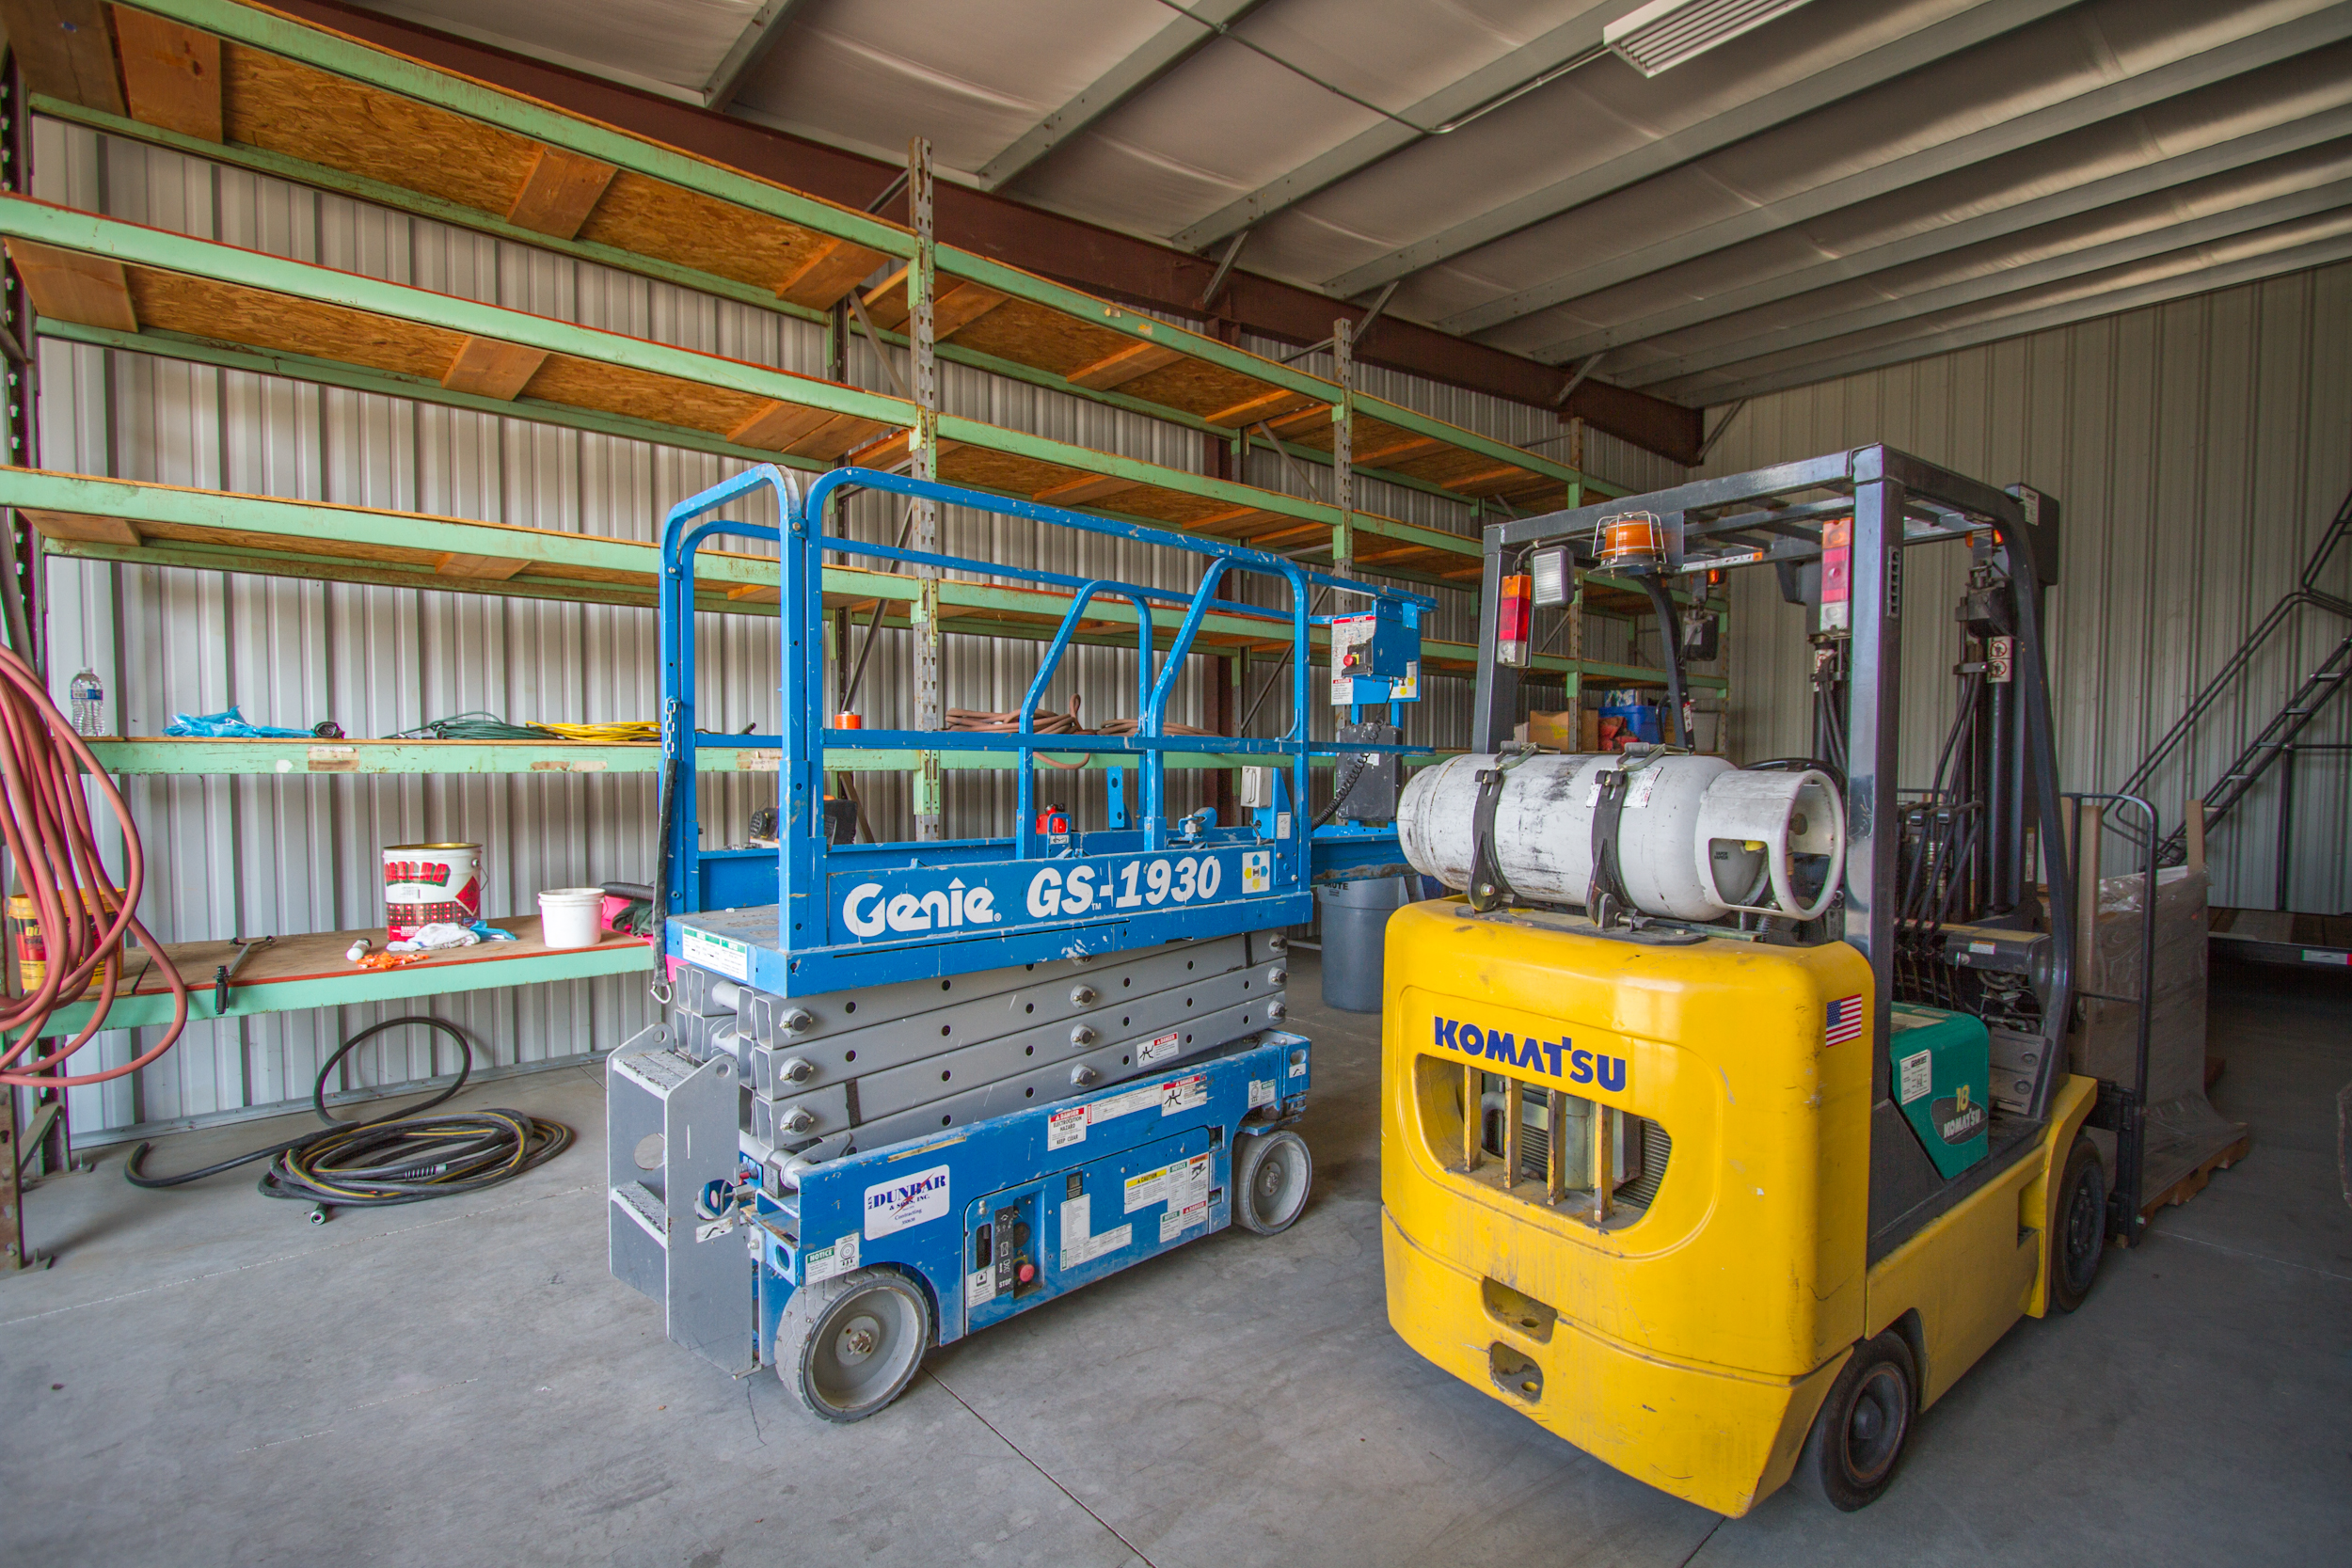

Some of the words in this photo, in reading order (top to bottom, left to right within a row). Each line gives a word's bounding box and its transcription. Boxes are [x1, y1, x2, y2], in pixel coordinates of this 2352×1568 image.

[1026, 856, 1221, 918] GS-1930
[843, 877, 994, 937] Genie
[1435, 1016, 1626, 1092] KOMATSU
[1956, 1085, 1970, 1112] 18
[1060, 1110, 1079, 1118] DANGER
[1053, 1116, 1082, 1128] ELECTROCUTION
[1060, 1123, 1075, 1132] HAZARD
[1943, 1108, 1980, 1138] KOMATSU
[1141, 1173, 1157, 1181] CAUTION
[873, 1175, 946, 1208] DUNBAR
[895, 1209, 922, 1220] Contracting
[810, 1249, 833, 1261] NOTICE
[999, 1278, 1012, 1288] STOP
